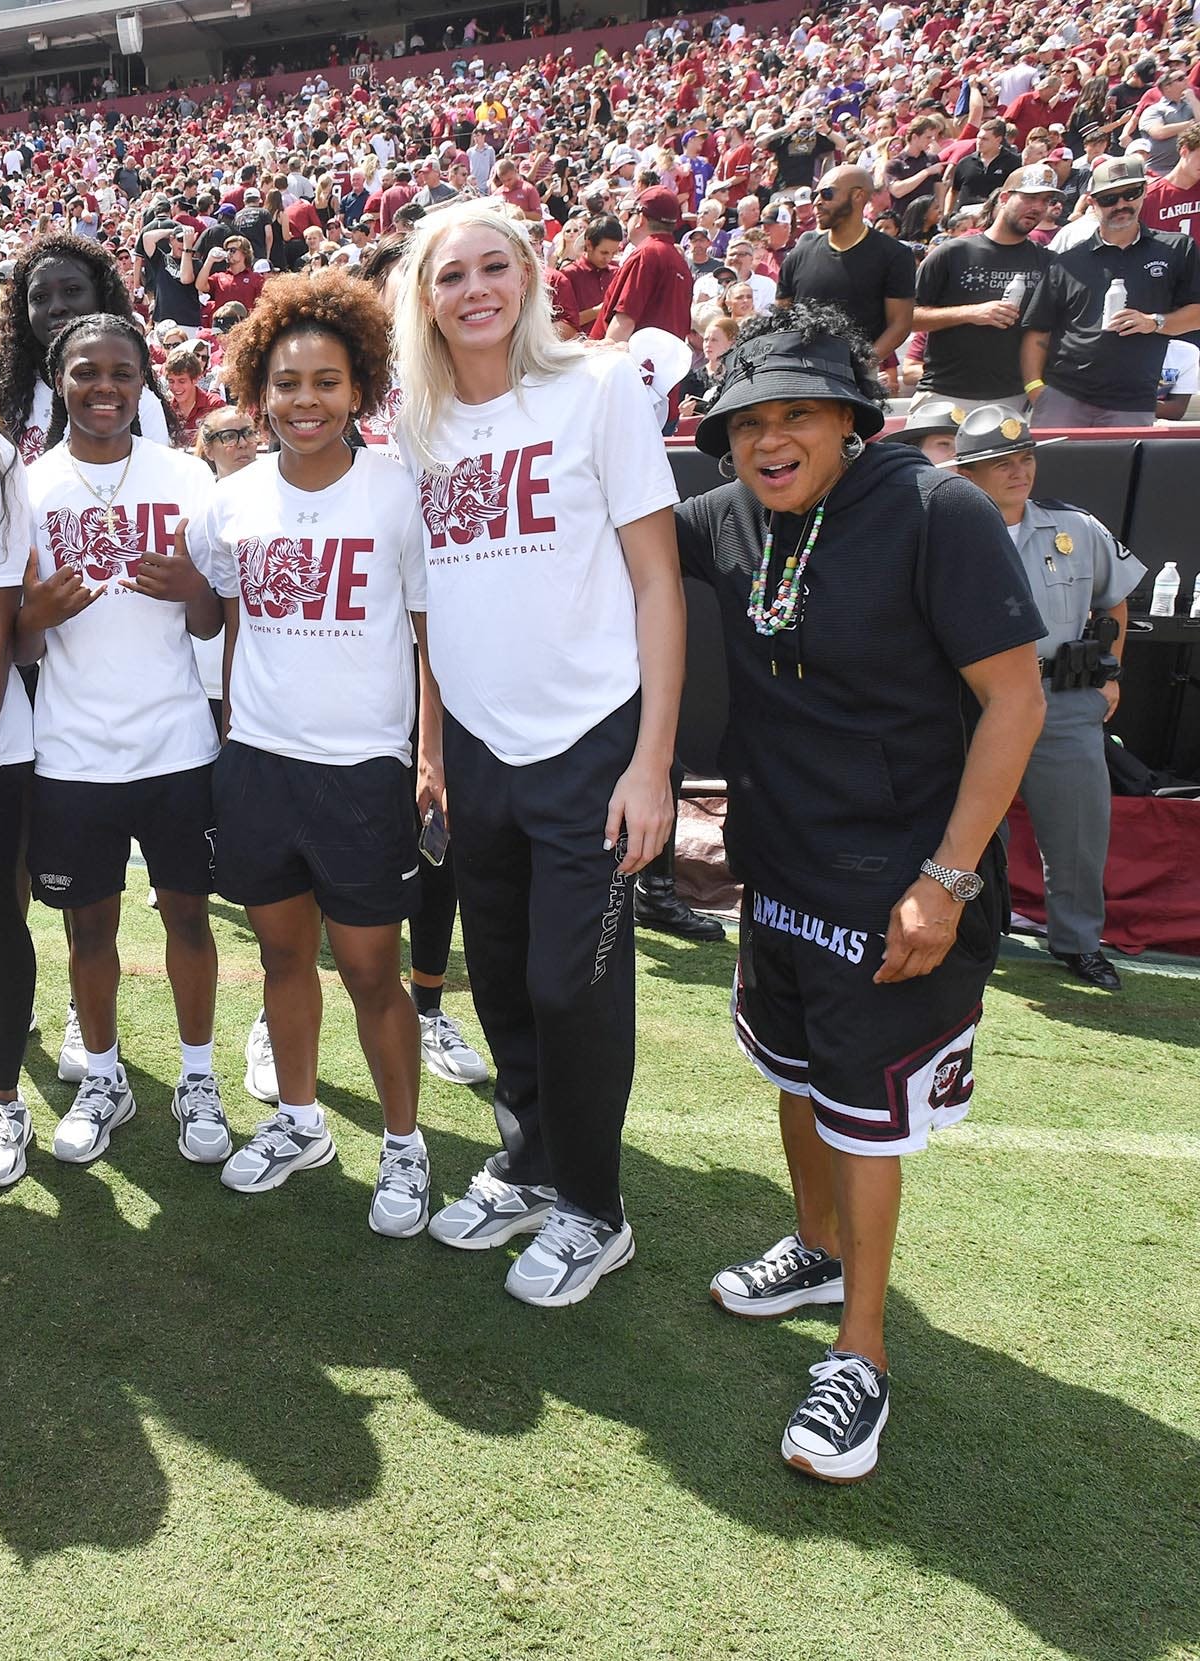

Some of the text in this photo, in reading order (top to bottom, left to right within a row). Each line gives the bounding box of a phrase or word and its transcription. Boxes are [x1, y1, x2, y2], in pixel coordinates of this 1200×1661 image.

[428, 543, 556, 567] WOMEN'S BASKETBALL
[235, 537, 375, 621] LOVE
[286, 627, 365, 638] BASKETBALL
